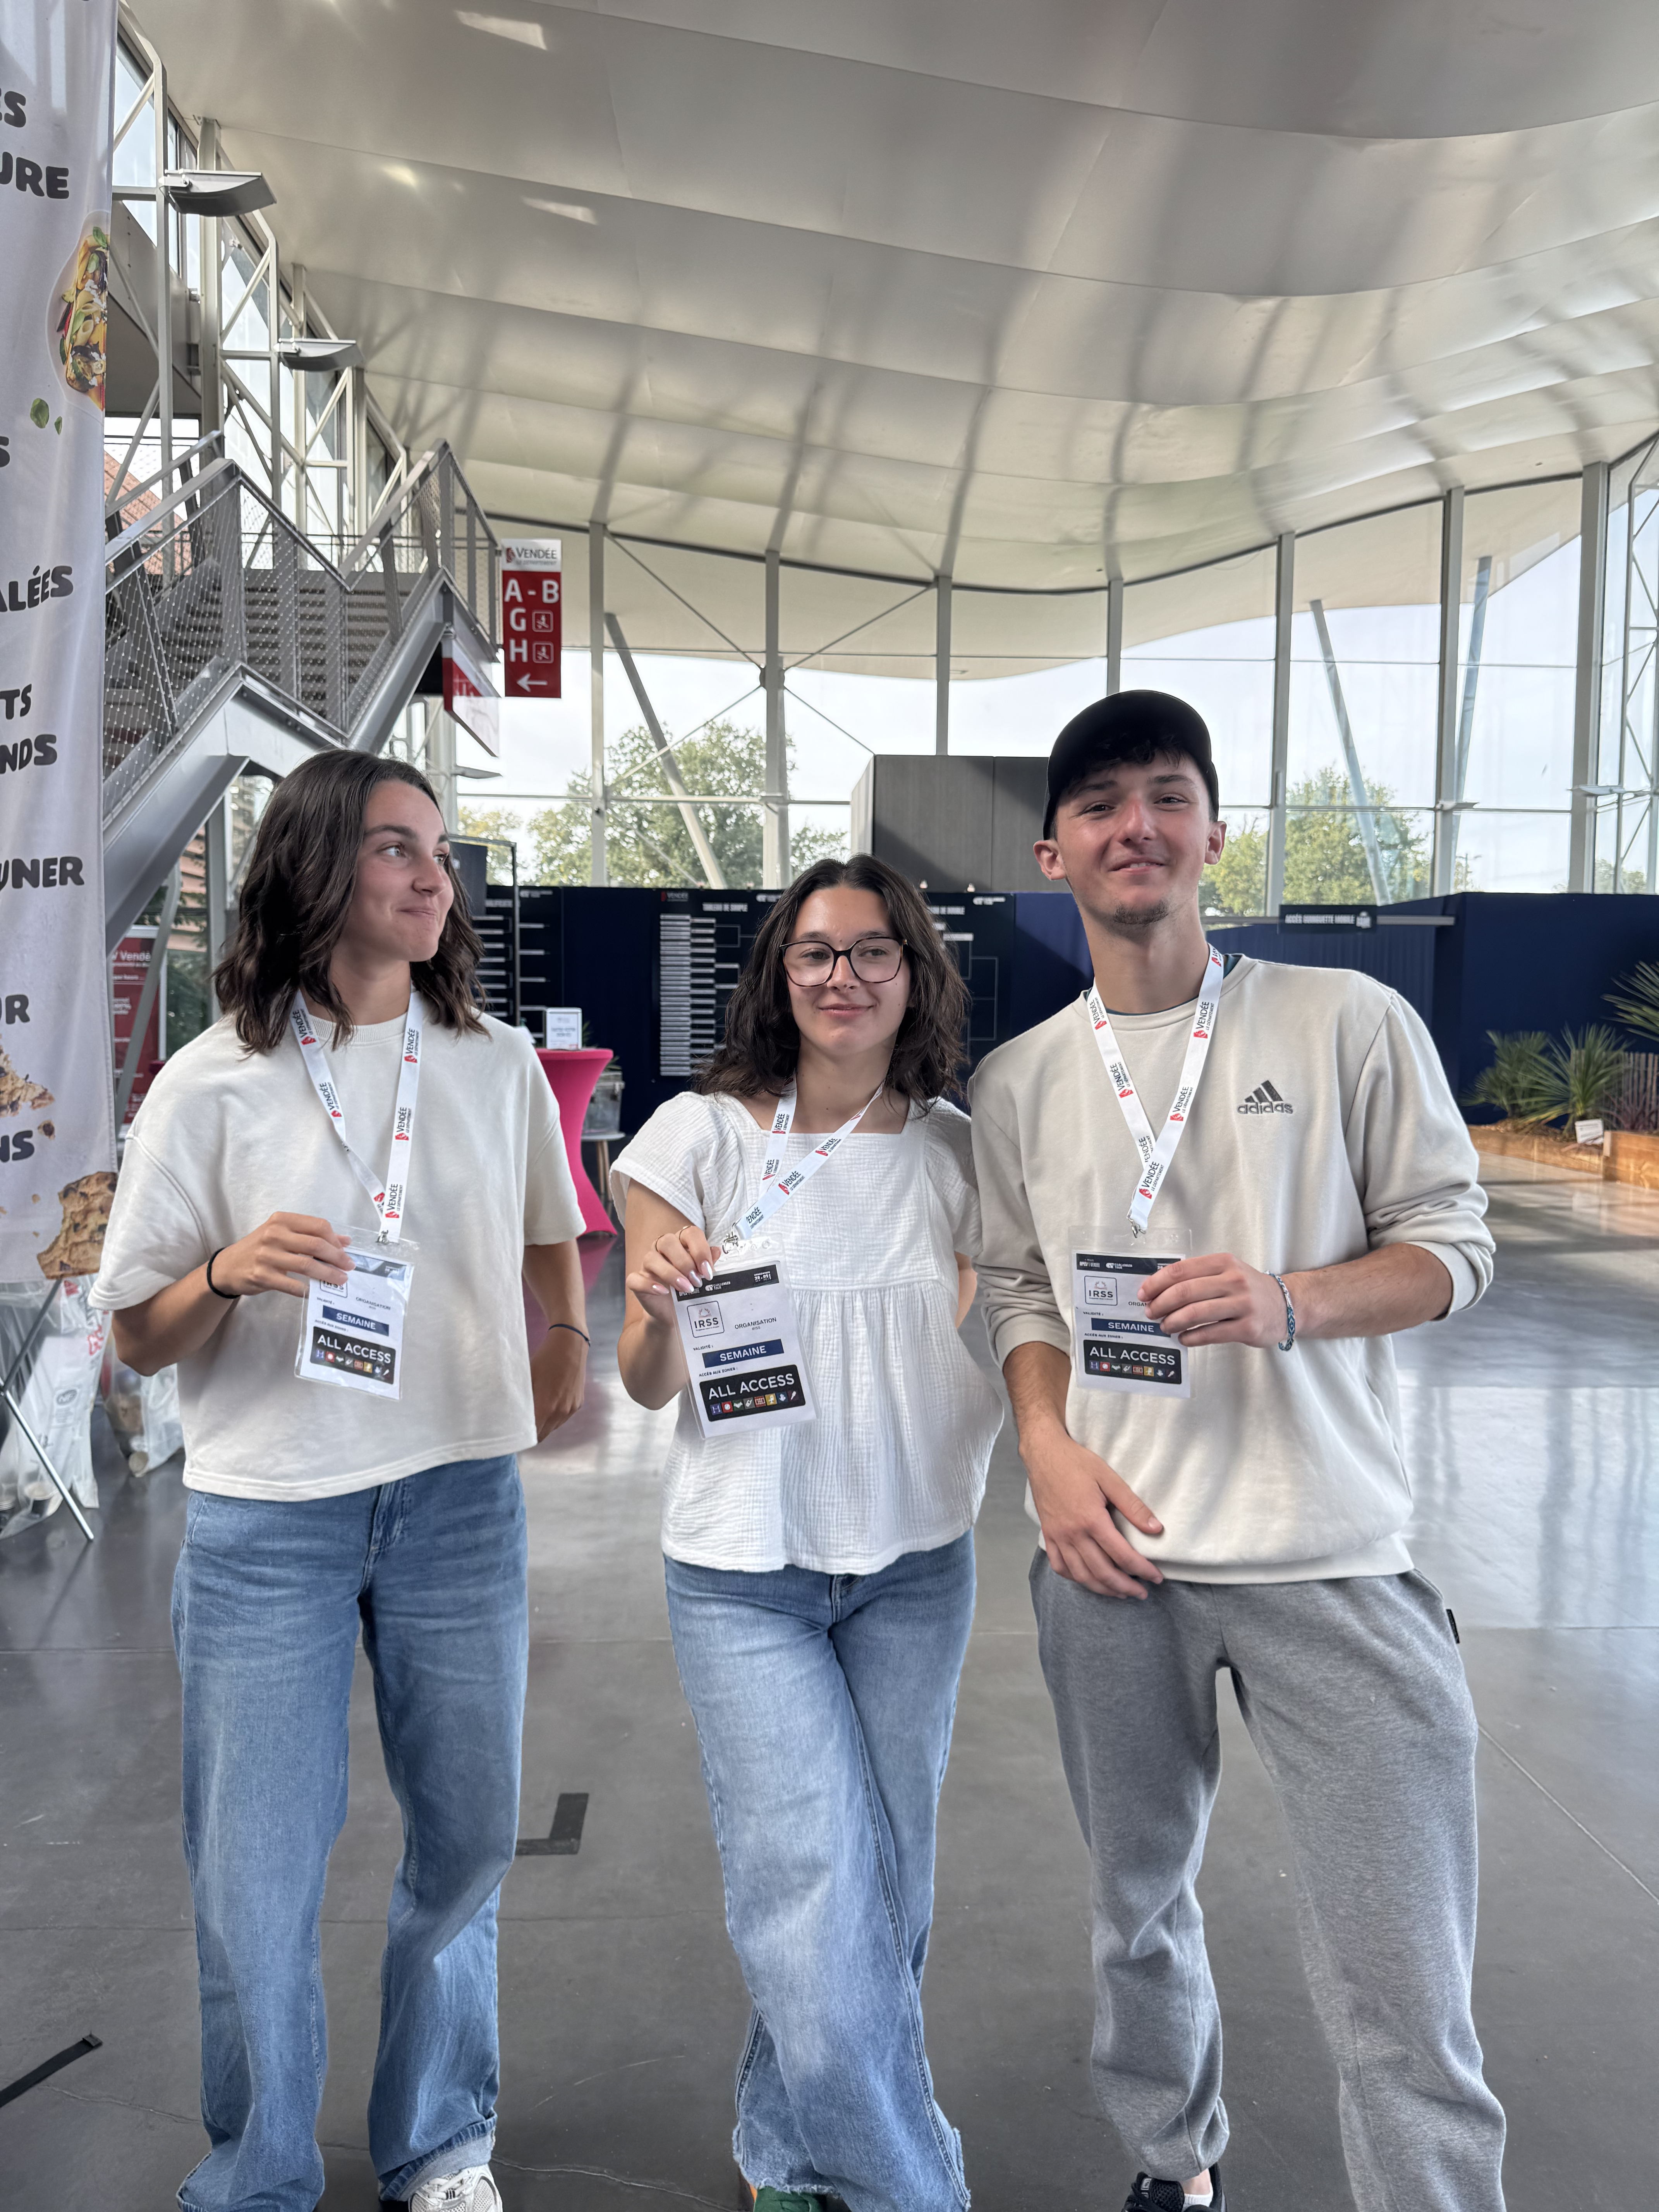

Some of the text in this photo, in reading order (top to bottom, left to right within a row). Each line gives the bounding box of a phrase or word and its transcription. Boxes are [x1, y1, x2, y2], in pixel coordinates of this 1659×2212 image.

[515, 547, 557, 559] VENDÉE
[504, 579, 523, 602] A
[542, 579, 559, 603] B
[510, 607, 526, 632] G
[509, 638, 528, 662] H
[292, 1010, 308, 1038] VENDÉE
[1089, 999, 1100, 1024] VENDÉE
[1195, 1001, 1209, 1029] VENDÉE
[405, 1028, 417, 1054] VENDÉE
[1110, 1063, 1125, 1091] VENDÉE
[319, 1082, 335, 1110] VENDÉE
[1172, 1087, 1189, 1112] VENDÉE
[1237, 1101, 1293, 1114] adidas
[396, 1107, 407, 1134] VENDÉE
[774, 1113, 785, 1130] VENDÉE
[1139, 1137, 1150, 1163] ENDÉE
[782, 1171, 801, 1187] VENDÉE
[1141, 1161, 1159, 1187] VENDÉE
[386, 1184, 398, 1211] VENDÉE
[336, 1312, 376, 1330] SEMAINE
[694, 1317, 719, 1328] IRSS
[735, 1317, 777, 1329] ORGANISATION
[1108, 1322, 1154, 1333] SEMAINE
[318, 1334, 391, 1364] ALL ACCESS
[720, 1345, 766, 1362] SEMAINE
[1090, 1346, 1175, 1365] ALL ACCESS
[709, 1374, 794, 1400] ALL ACCESS
